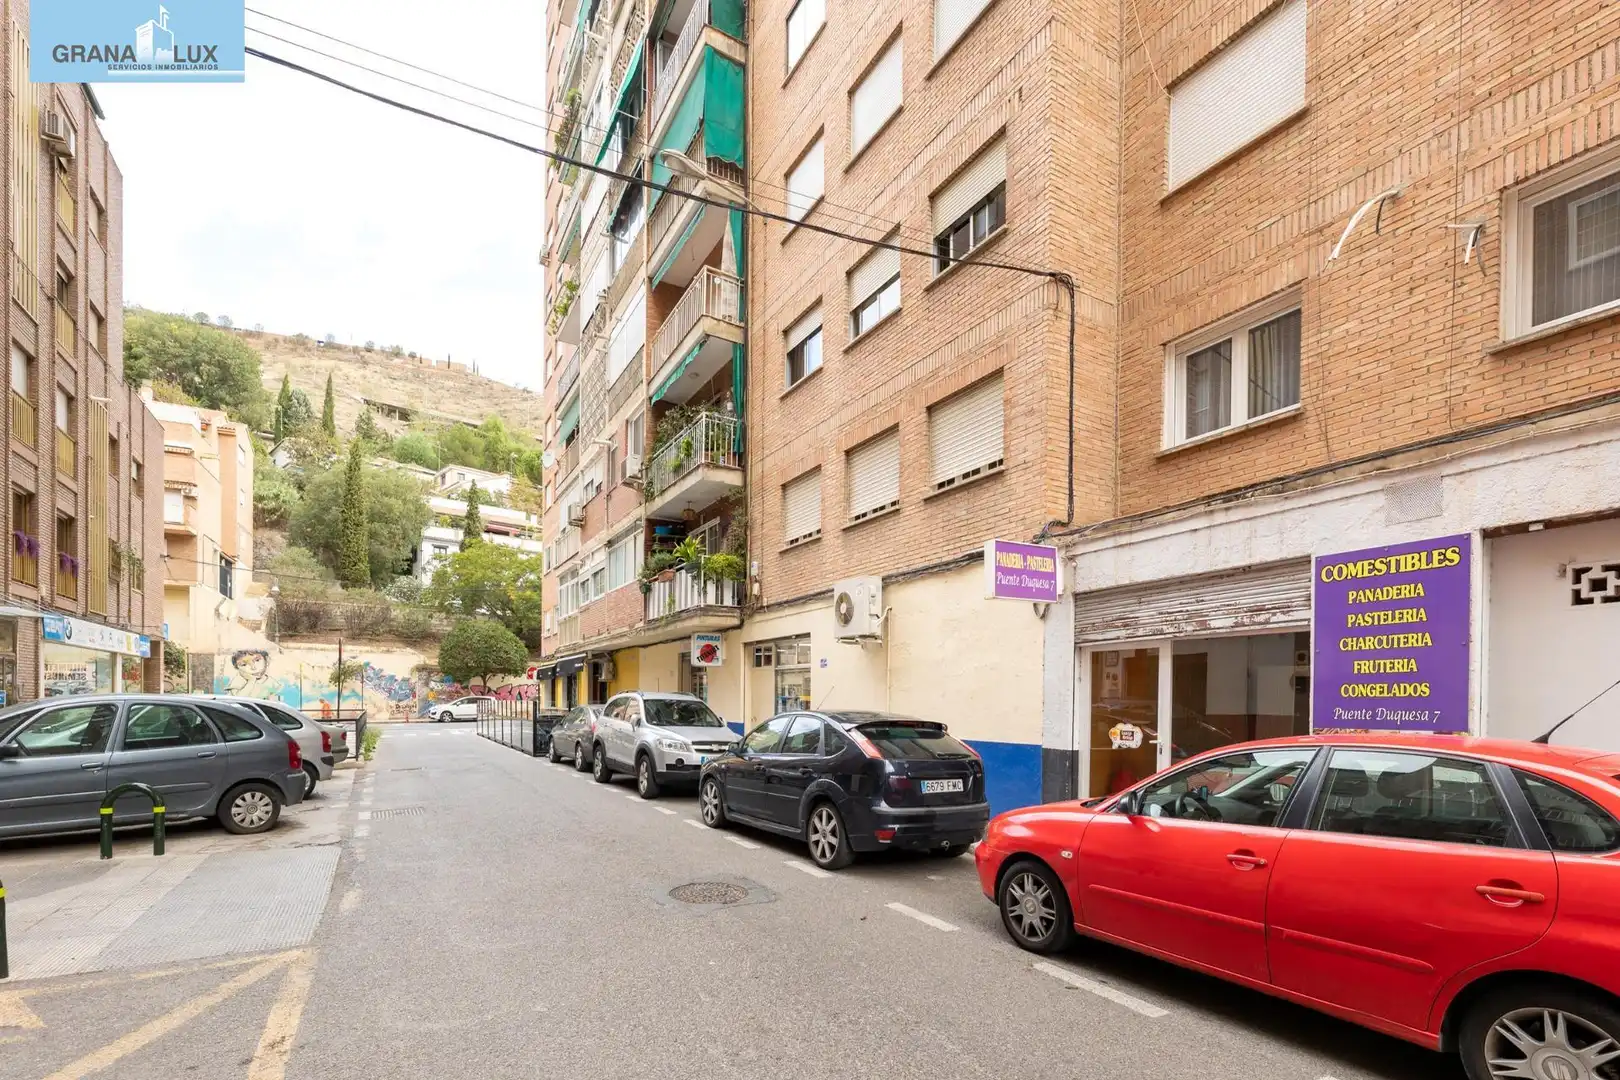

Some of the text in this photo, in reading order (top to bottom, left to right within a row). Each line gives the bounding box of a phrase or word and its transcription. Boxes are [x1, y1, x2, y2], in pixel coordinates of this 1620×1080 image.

[996, 551, 1024, 569] PANADERIA
[1026, 555, 1055, 573] PASTELERIA
[1320, 546, 1461, 583] COMESTIBLES
[997, 571, 1055, 592] Puente Duquesa 7
[1347, 582, 1424, 604] PANADERIA
[1346, 607, 1427, 628] PASTELERIA
[1339, 632, 1433, 651] CHARCUTERIA
[1353, 658, 1418, 674] FRUTERIA
[1340, 682, 1430, 698] CONGELADOS
[1333, 707, 1441, 725] Puente Duquesa 7
